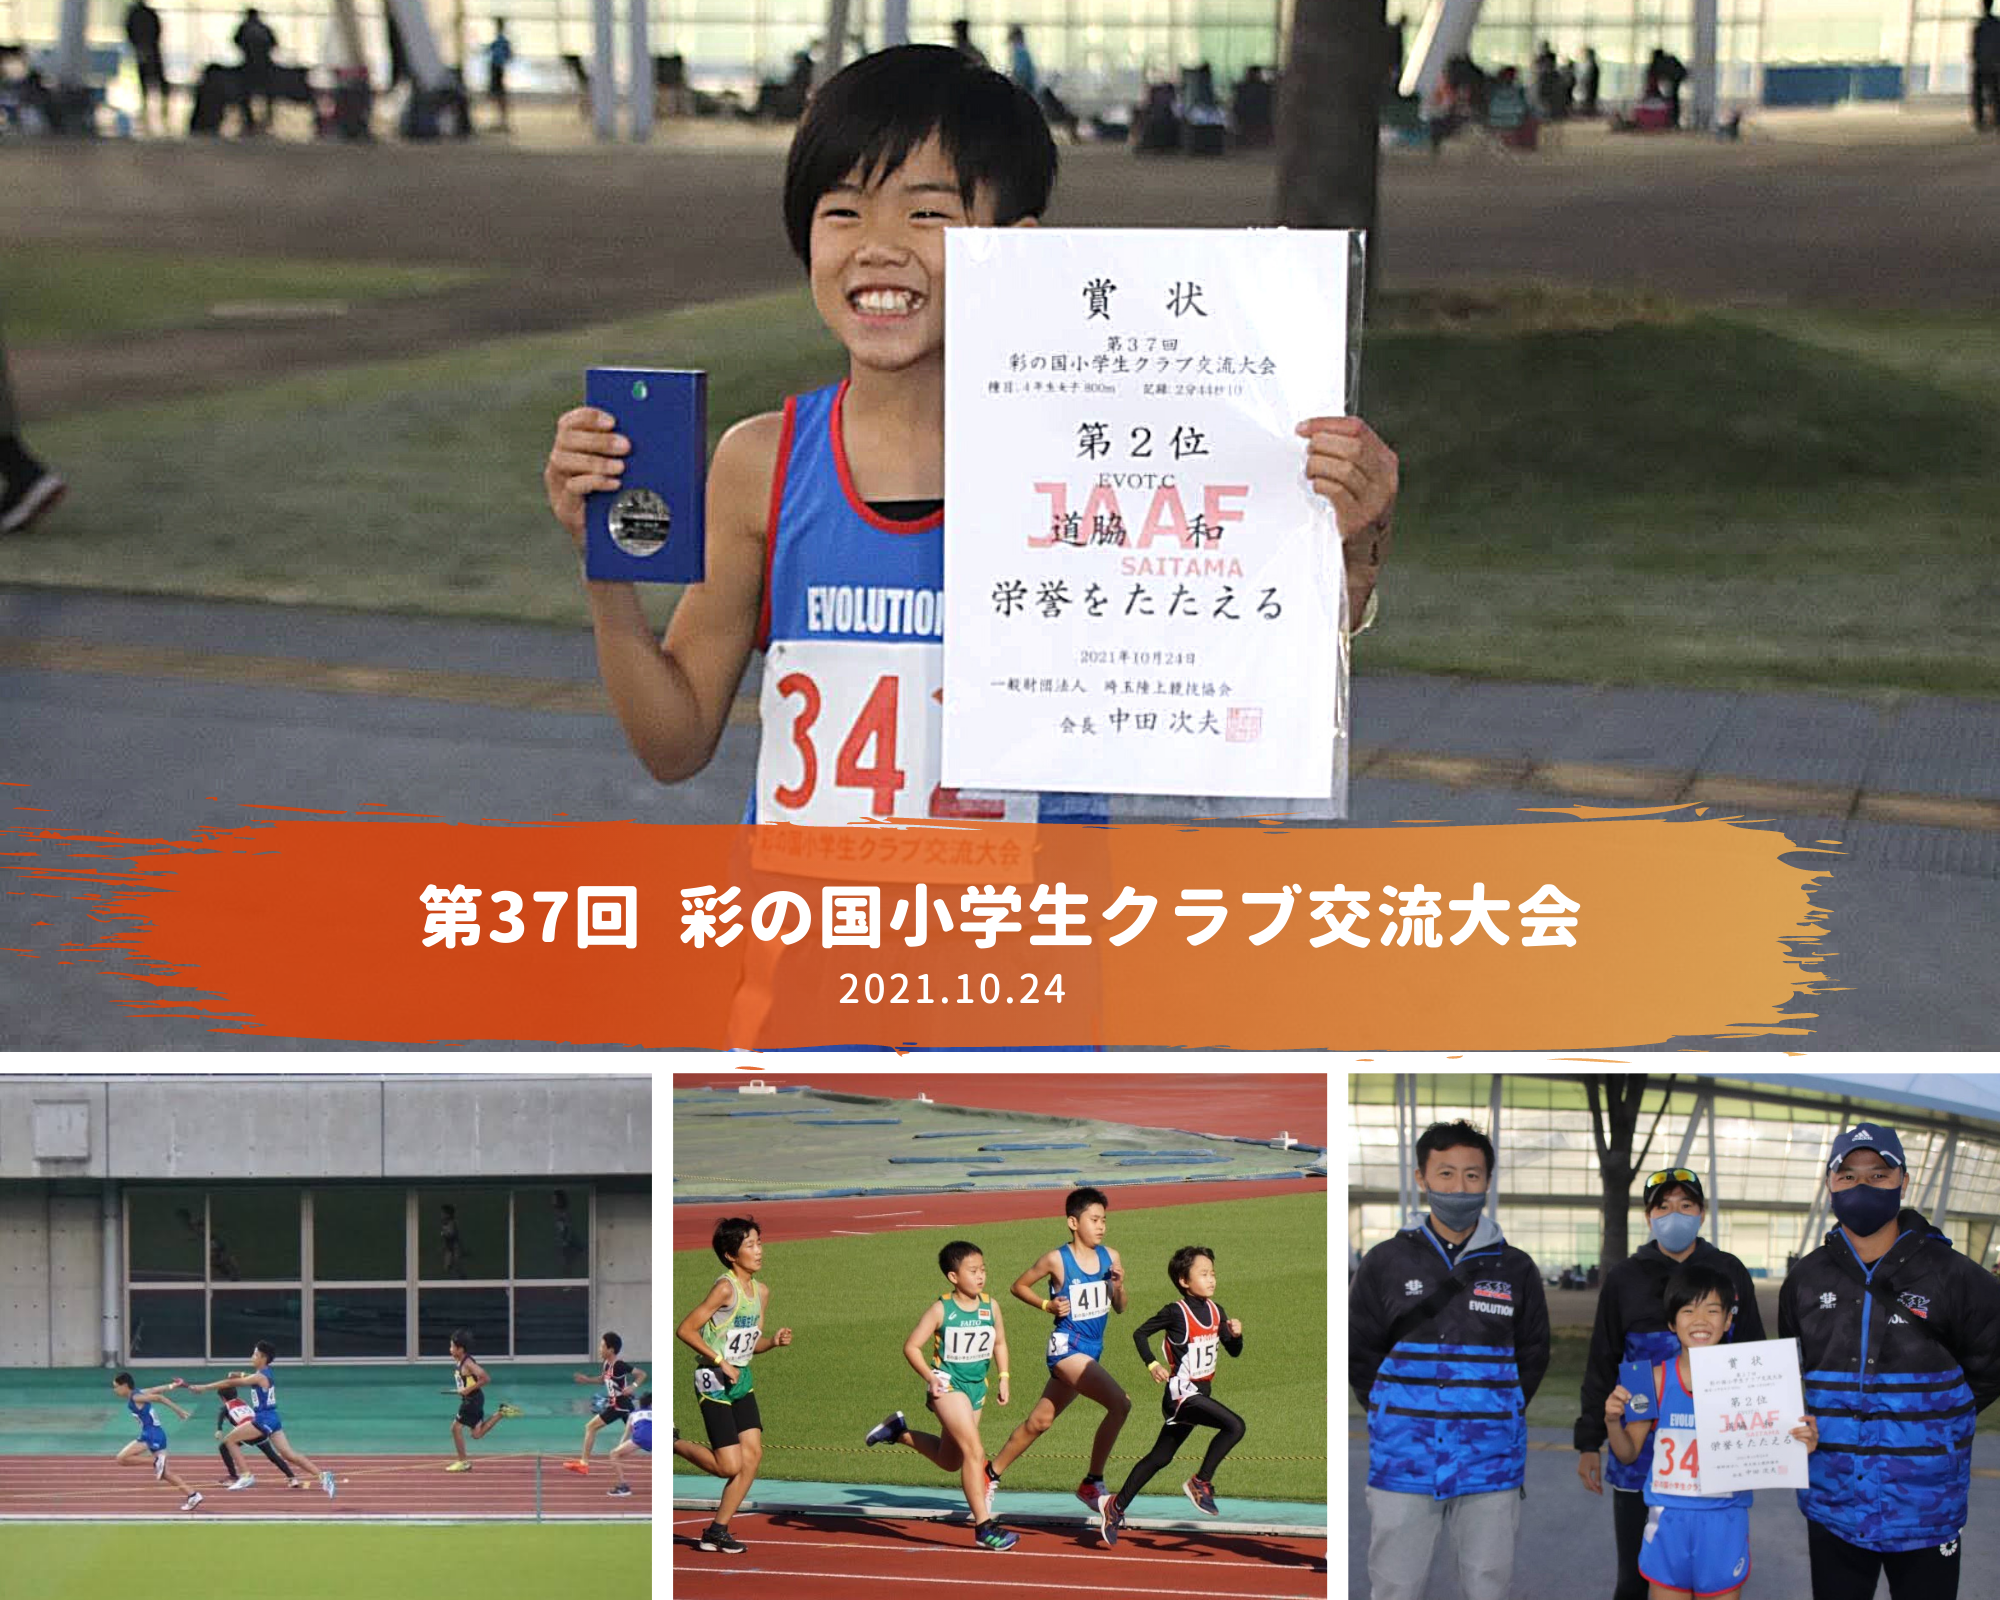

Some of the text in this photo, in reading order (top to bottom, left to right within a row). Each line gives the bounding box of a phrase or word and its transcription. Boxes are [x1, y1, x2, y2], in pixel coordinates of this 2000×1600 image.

[1010, 353, 1278, 376] 彩の国小学生クラブ交流大会
[1027, 482, 1250, 551] JAAF
[1121, 557, 1244, 578] SAITAMA
[991, 579, 1283, 620] 栄誉をたたえる
[1080, 650, 1196, 666] 2021年10月24日
[991, 678, 1233, 697] 一般財団法人 埼玉陸上競技協会
[1060, 716, 1097, 735] 会長
[774, 672, 1005, 819] 34
[1469, 1300, 1514, 1317] EVOLUTION
[952, 1331, 990, 1353] 172
[702, 1372, 711, 1389] 8
[1670, 1413, 1695, 1427] EVOLU
[1719, 1410, 1780, 1433] JAAF
[1659, 1437, 1699, 1479] 34
